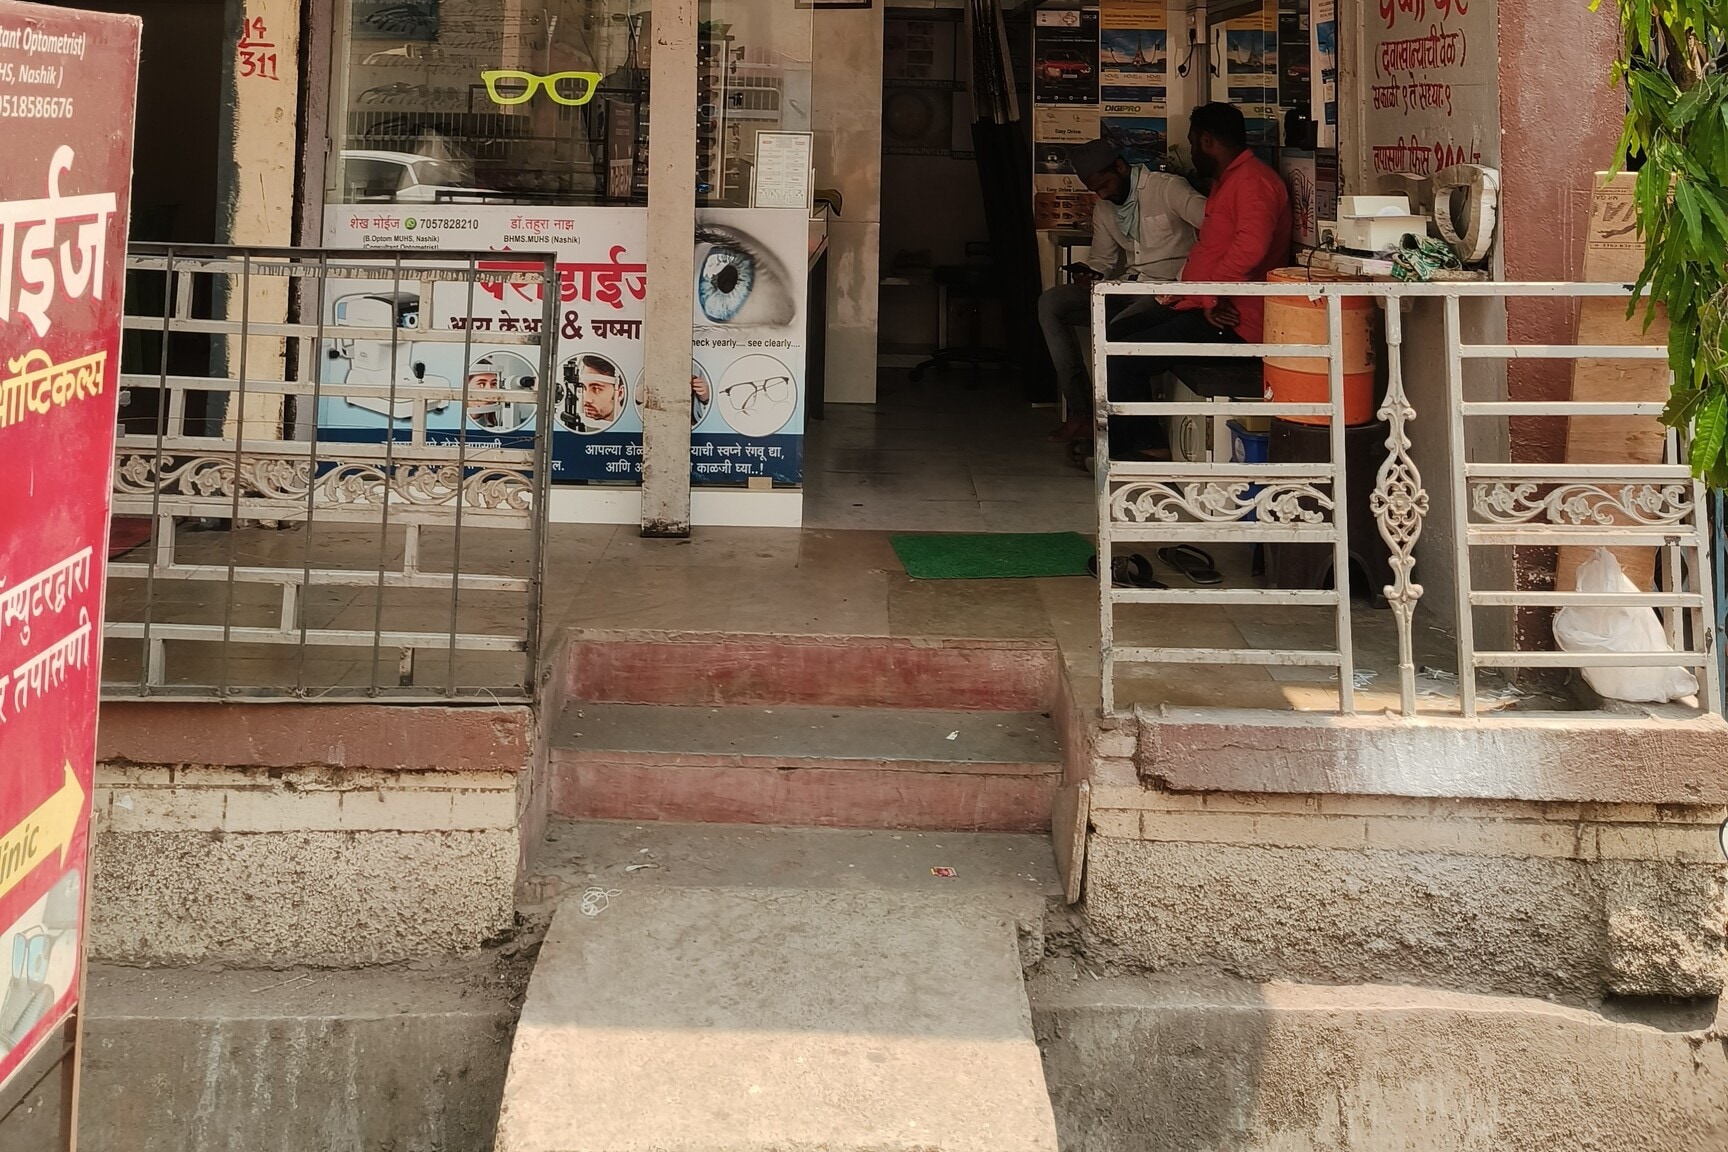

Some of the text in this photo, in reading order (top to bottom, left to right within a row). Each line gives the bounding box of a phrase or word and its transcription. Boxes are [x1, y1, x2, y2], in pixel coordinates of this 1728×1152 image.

[244, 16, 267, 39] 14
[23, 27, 86, 61] Optometrist)
[19, 64, 57, 84] Nashik
[240, 51, 280, 81] 311
[0, 95, 73, 118] 518586676
[350, 215, 479, 230] शेख मोईज 7057828210
[551, 235, 581, 245] (Nashik)
[561, 310, 583, 339] &
[591, 320, 642, 340] चष्मा
[748, 339, 762, 347] see
[585, 444, 621, 456] आपल्या
[605, 459, 631, 473] आणि
[13, 606, 92, 714] तपासणी
[0, 822, 39, 884] inic
